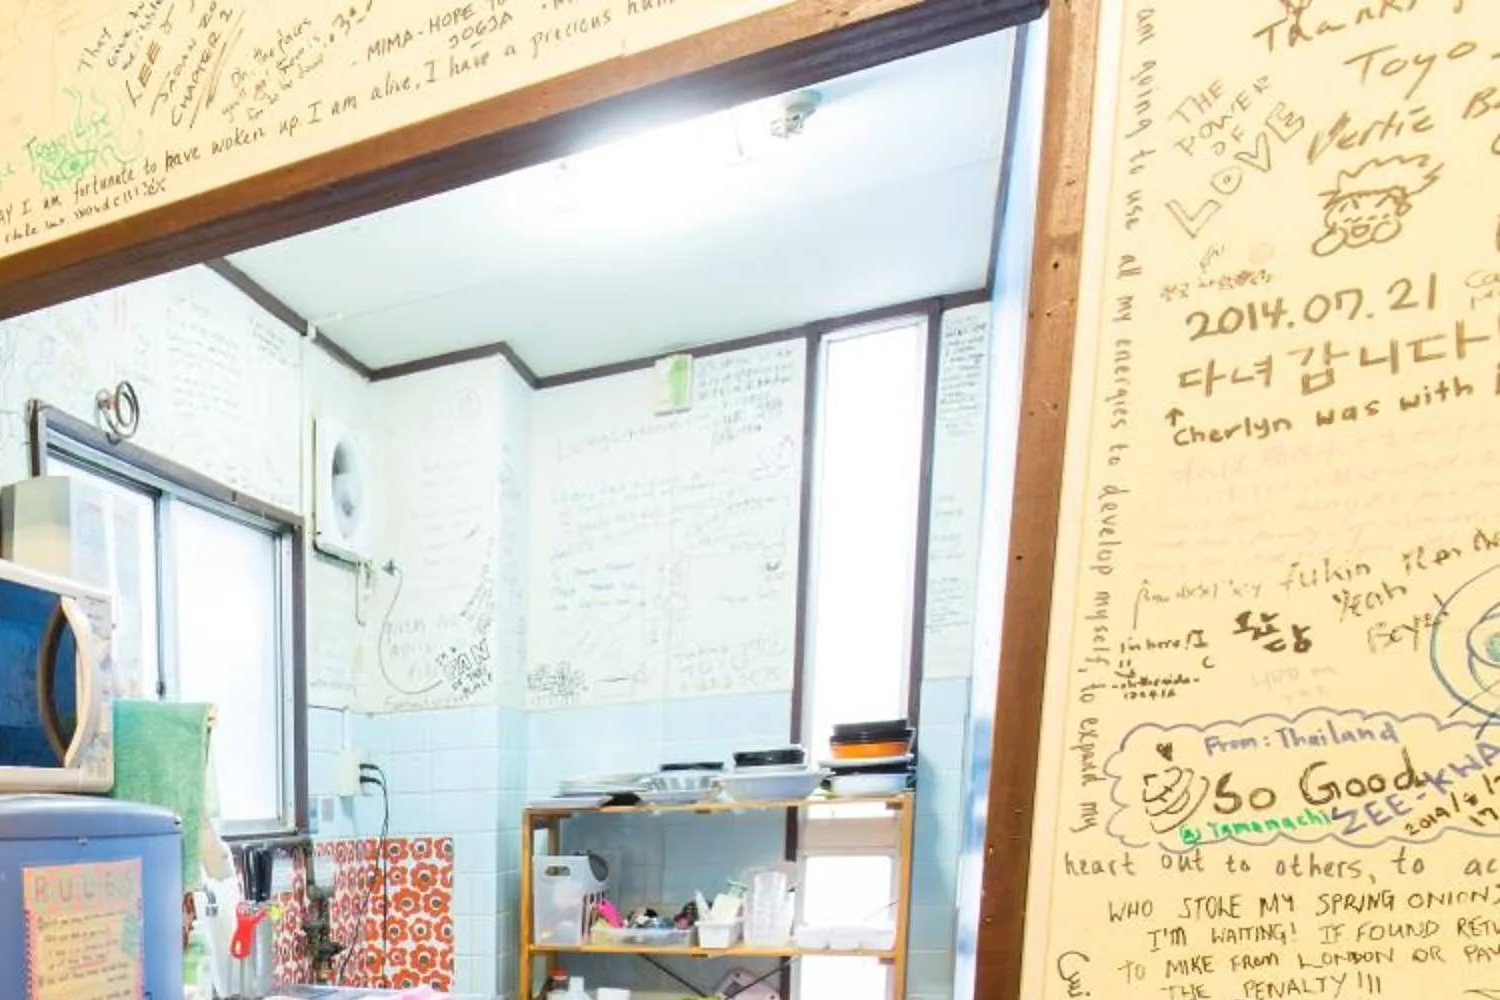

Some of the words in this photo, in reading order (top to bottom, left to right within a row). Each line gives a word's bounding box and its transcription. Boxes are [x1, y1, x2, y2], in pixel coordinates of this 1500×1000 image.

[1343, 41, 1478, 100] Toyo
[144, 158, 157, 174] to
[165, 147, 201, 171] have
[211, 127, 266, 155] woken
[308, 100, 322, 124] I
[332, 95, 358, 116] am
[450, 52, 490, 77] have
[503, 45, 516, 57] a
[531, 8, 611, 59] precious
[1125, 60, 1156, 139] going
[1117, 254, 1142, 279] all
[1112, 295, 1133, 321] my
[1316, 400, 1381, 428] was
[1398, 376, 1474, 411] with
[1090, 485, 1130, 576] develop
[1069, 717, 1106, 786] expand
[1275, 719, 1399, 748] Thailand
[1070, 802, 1098, 832] my
[1064, 851, 1136, 876] heart
[1161, 848, 1205, 873] out
[1226, 854, 1251, 873] to
[1276, 852, 1376, 885] others,
[1391, 846, 1425, 874] to
[1108, 899, 1154, 923] WHO
[1178, 893, 1243, 919] STOLE
[1259, 892, 1294, 917] MY
[1316, 889, 1395, 916] SPRING
[1147, 926, 1187, 952] I'M
[1319, 923, 1346, 945] IF
[1356, 920, 1439, 942] FOUND
[1117, 960, 1146, 984] TO
[1165, 956, 1215, 978] MIKE
[1298, 948, 1394, 969] LONDON
[1412, 947, 1446, 963] OR
[1160, 983, 1212, 1000] THE
